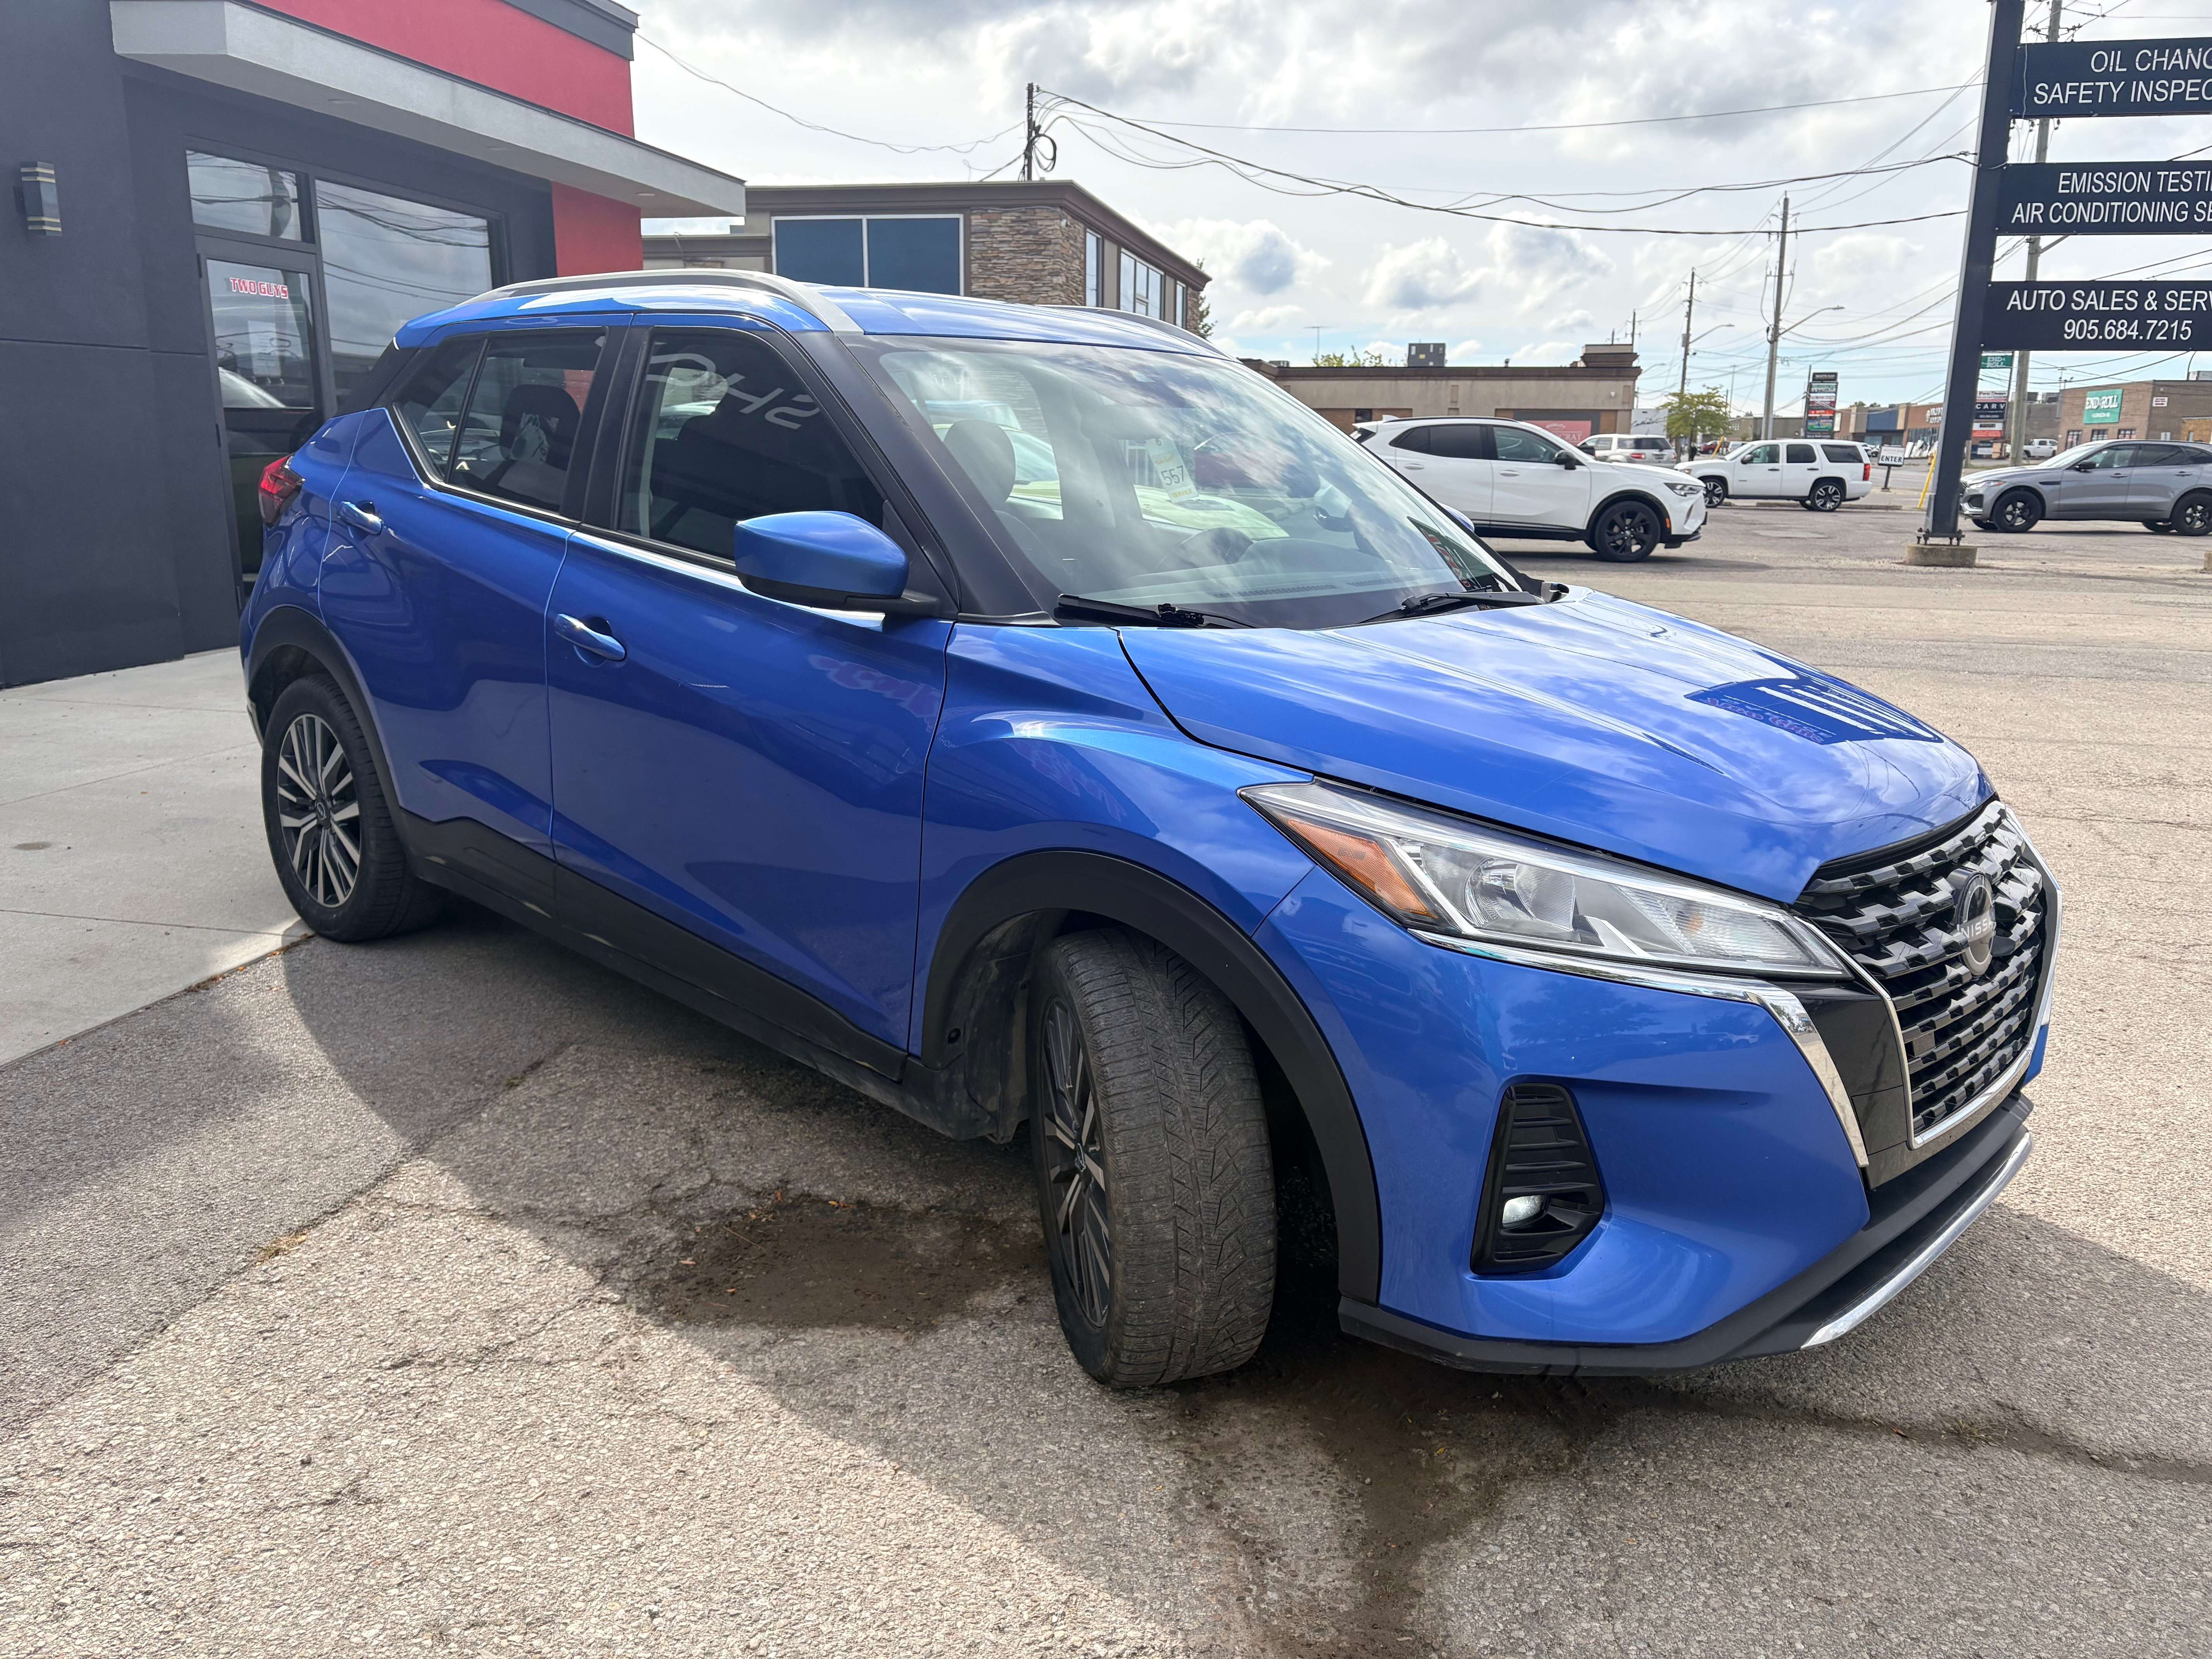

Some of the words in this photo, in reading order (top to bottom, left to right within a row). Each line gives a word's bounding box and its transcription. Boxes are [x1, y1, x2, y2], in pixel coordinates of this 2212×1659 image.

[2091, 50, 2127, 72] OIL
[2135, 47, 2212, 71] CHANG
[2034, 81, 2125, 104] SAFETY
[2058, 172, 2151, 193] EMISSION
[2157, 170, 2212, 192] TESTI
[2011, 203, 2044, 223] AIR
[2049, 201, 2189, 223] CONDITIONING
[230, 277, 257, 294] TWO
[258, 281, 289, 299] GUYS
[2006, 290, 2066, 310] AUTO
[2071, 290, 2138, 311] SALES
[2144, 290, 2158, 311] &
[2164, 290, 2212, 311] SER
[2064, 319, 2192, 340] 905.684.7215
[1161, 465, 1185, 486] 557
